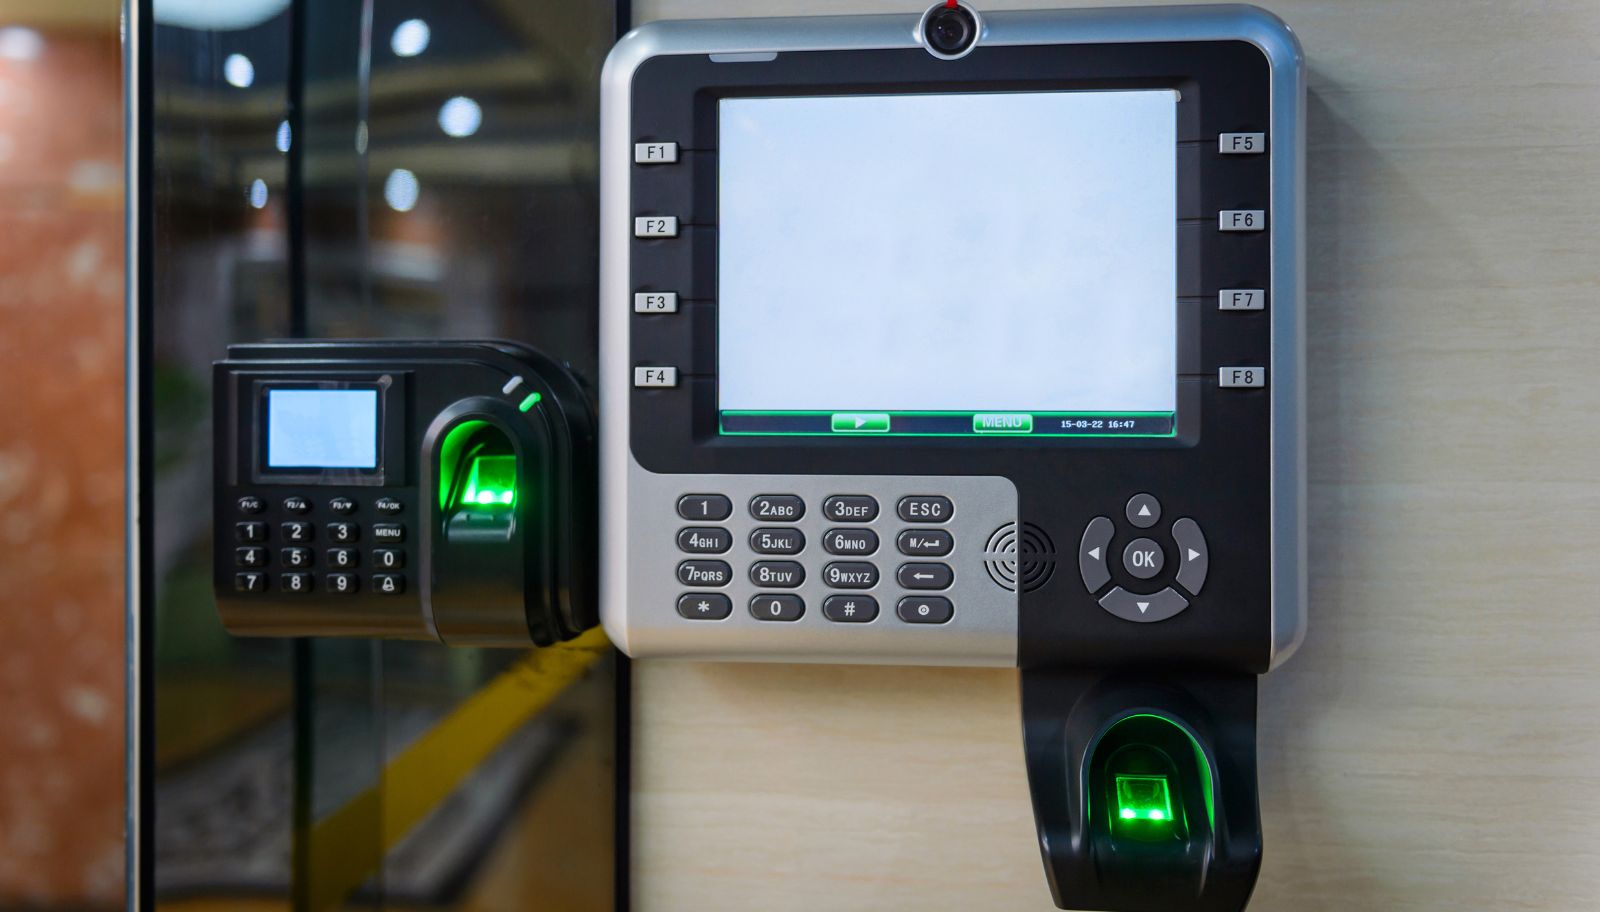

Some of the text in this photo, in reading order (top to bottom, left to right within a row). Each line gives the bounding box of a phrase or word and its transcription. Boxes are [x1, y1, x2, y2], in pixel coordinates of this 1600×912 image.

[1232, 136, 1253, 150] F5
[647, 146, 664, 159] F1
[646, 220, 666, 233] F2
[1232, 213, 1253, 227] F6
[646, 296, 665, 309] F3
[1232, 293, 1253, 307] F7
[646, 370, 665, 383] F4
[1232, 370, 1254, 384] F8
[982, 417, 1022, 428] MENU
[1061, 420, 1135, 428] 15-03-22 16:47
[701, 501, 708, 514] 1
[910, 503, 940, 516] ESC
[247, 525, 254, 538] 1
[292, 525, 301, 539] 2
[338, 525, 347, 539] 3
[376, 529, 400, 537] MENU
[245, 550, 255, 563] 4
[291, 550, 301, 564] 5
[338, 551, 347, 565] 6
[384, 552, 394, 566] 0
[1132, 551, 1155, 567] OK
[247, 575, 256, 589] 7
[291, 576, 301, 589] 8
[337, 576, 347, 590] 9
[770, 601, 781, 615] 0
[844, 602, 855, 616] #
